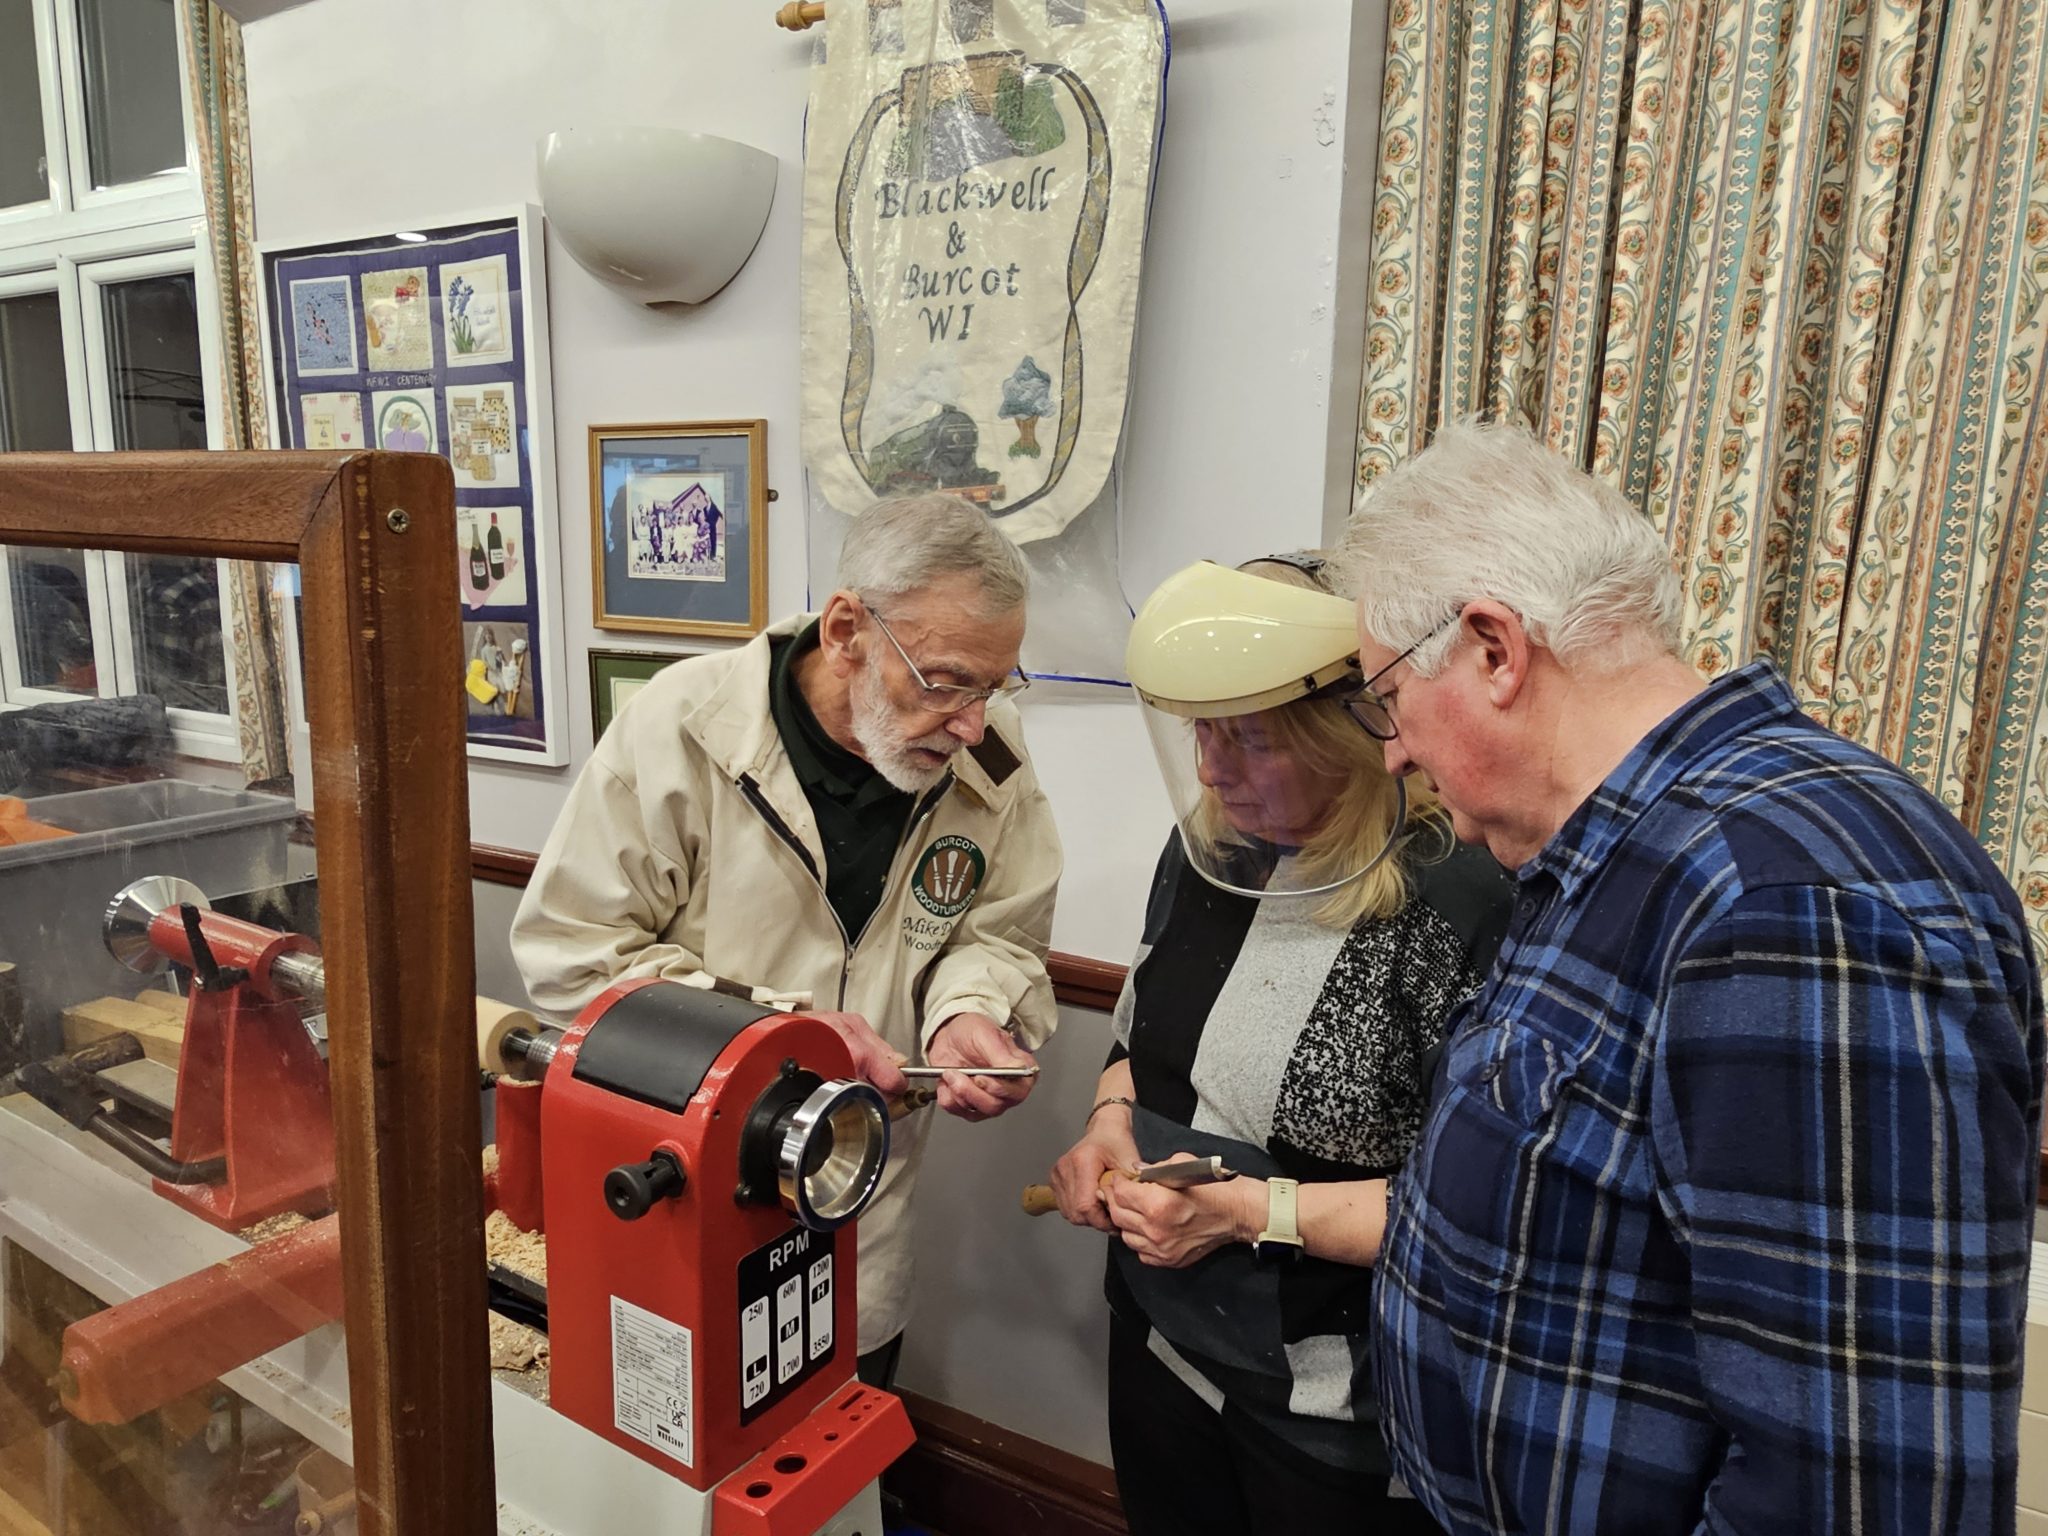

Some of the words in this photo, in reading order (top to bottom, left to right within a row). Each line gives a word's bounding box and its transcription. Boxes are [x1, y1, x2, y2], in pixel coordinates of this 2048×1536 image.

[875, 166, 1056, 219] Blackwell
[946, 221, 966, 259] &
[903, 263, 1020, 300] Burcot
[918, 304, 974, 343] WI
[935, 836, 977, 853] BURCOT
[914, 885, 977, 916] WOODTURNERS
[902, 916, 940, 937] Mike
[769, 1230, 809, 1272] RPM
[812, 1257, 830, 1278] 1200
[783, 1279, 796, 1299] 600
[817, 1282, 825, 1299] H
[748, 1302, 763, 1322] 250
[785, 1324, 795, 1339] M
[812, 1332, 830, 1355] 3550
[753, 1363, 761, 1375] L
[782, 1355, 799, 1378] 1700
[750, 1381, 764, 1400] 720
